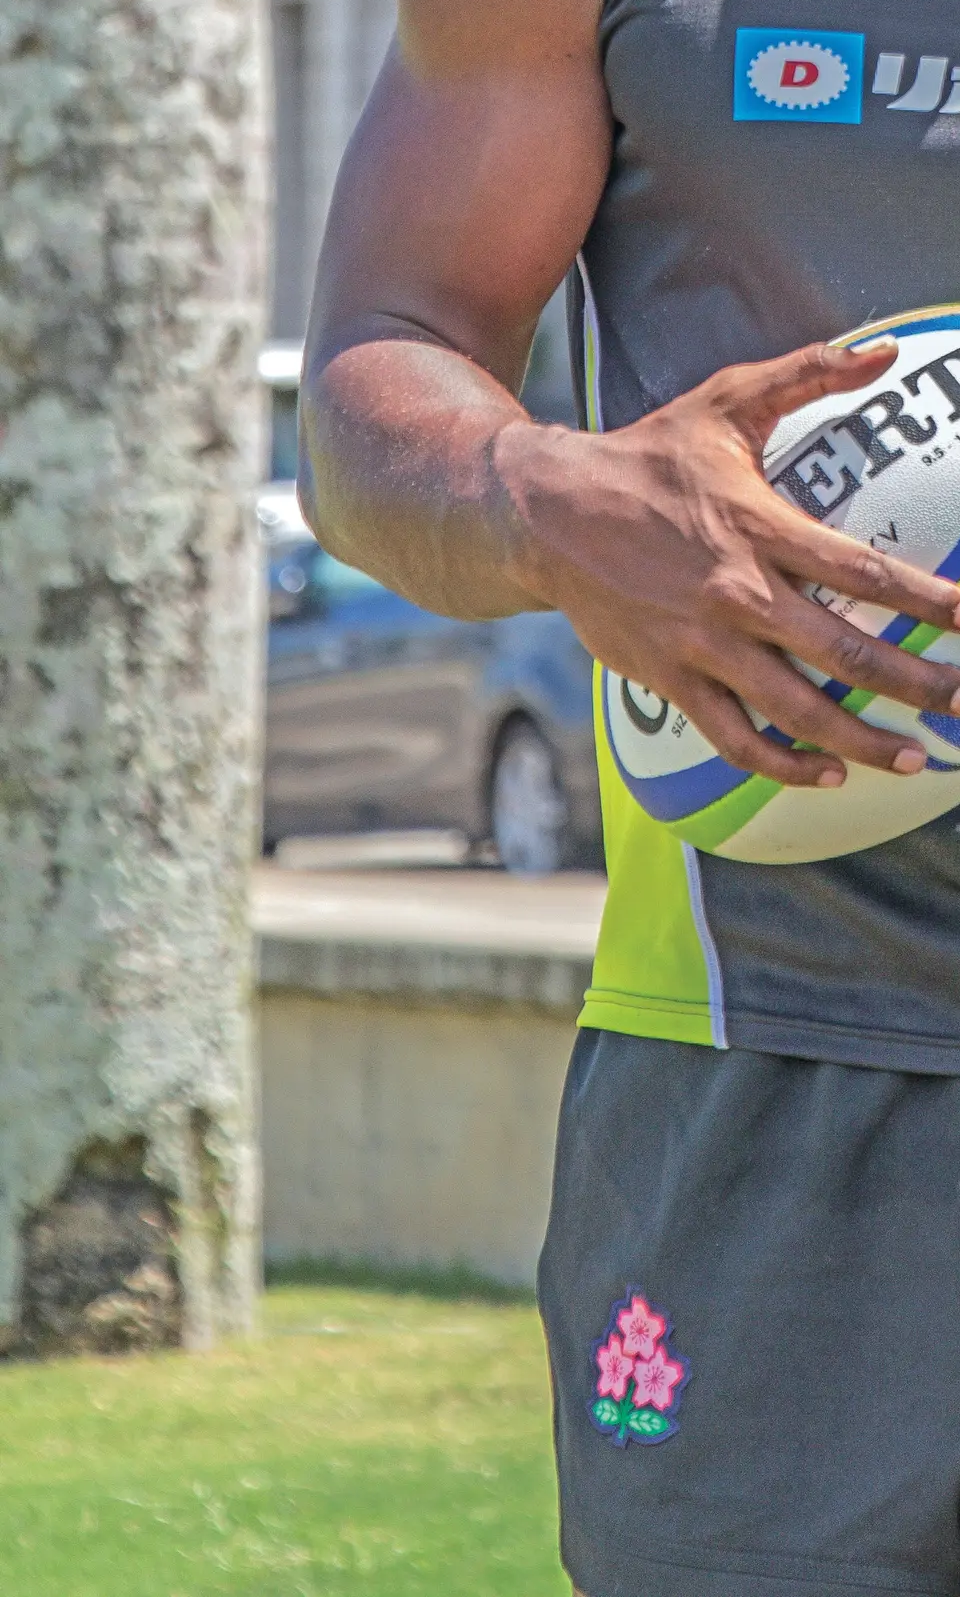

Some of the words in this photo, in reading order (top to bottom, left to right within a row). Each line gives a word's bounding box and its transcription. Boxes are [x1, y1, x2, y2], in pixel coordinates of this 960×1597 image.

[779, 60, 820, 89] D
[921, 446, 945, 467] 9.5
[670, 713, 689, 739] SIZ
